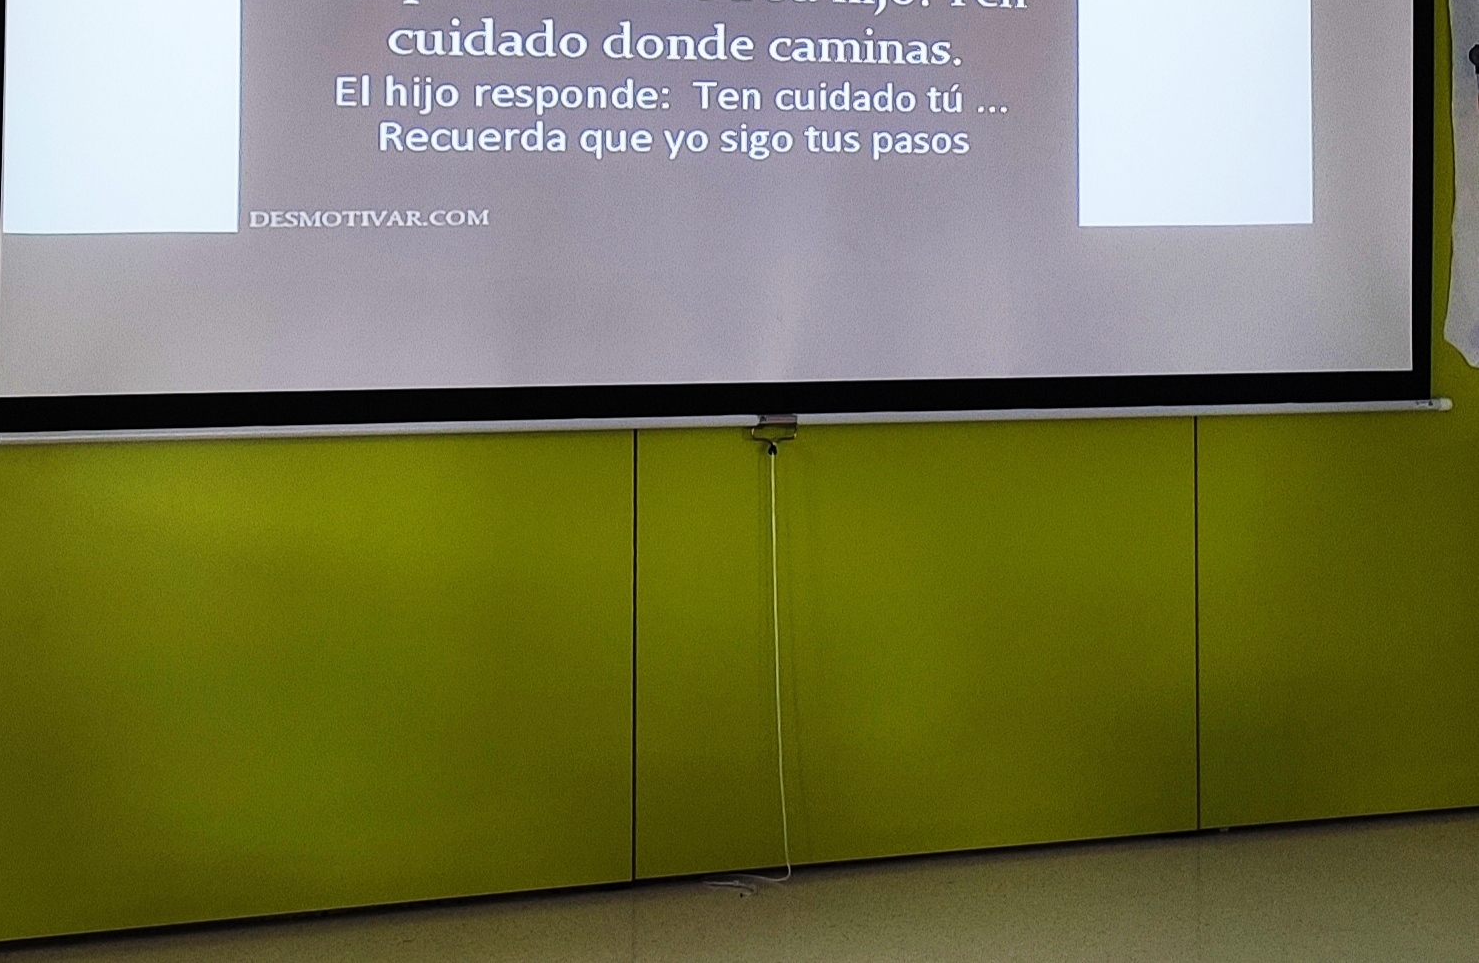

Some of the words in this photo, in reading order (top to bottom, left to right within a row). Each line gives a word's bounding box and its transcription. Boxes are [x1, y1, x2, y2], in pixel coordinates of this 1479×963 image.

[387, 17, 588, 58] cuidado
[602, 20, 755, 61] donde
[768, 27, 962, 66] caminas.
[335, 74, 370, 107] El
[385, 74, 460, 115] hijo
[474, 78, 671, 115] responde:
[692, 81, 762, 110] Ten
[774, 81, 916, 113] cuidado
[927, 84, 963, 113] tú
[378, 120, 567, 152] Recuerda
[579, 128, 653, 160] que
[663, 129, 709, 160] yo
[720, 123, 794, 160] sigo
[804, 126, 861, 153] tus
[872, 130, 970, 160] pasos
[249, 209, 490, 228] DESMOTIVAR.COM
